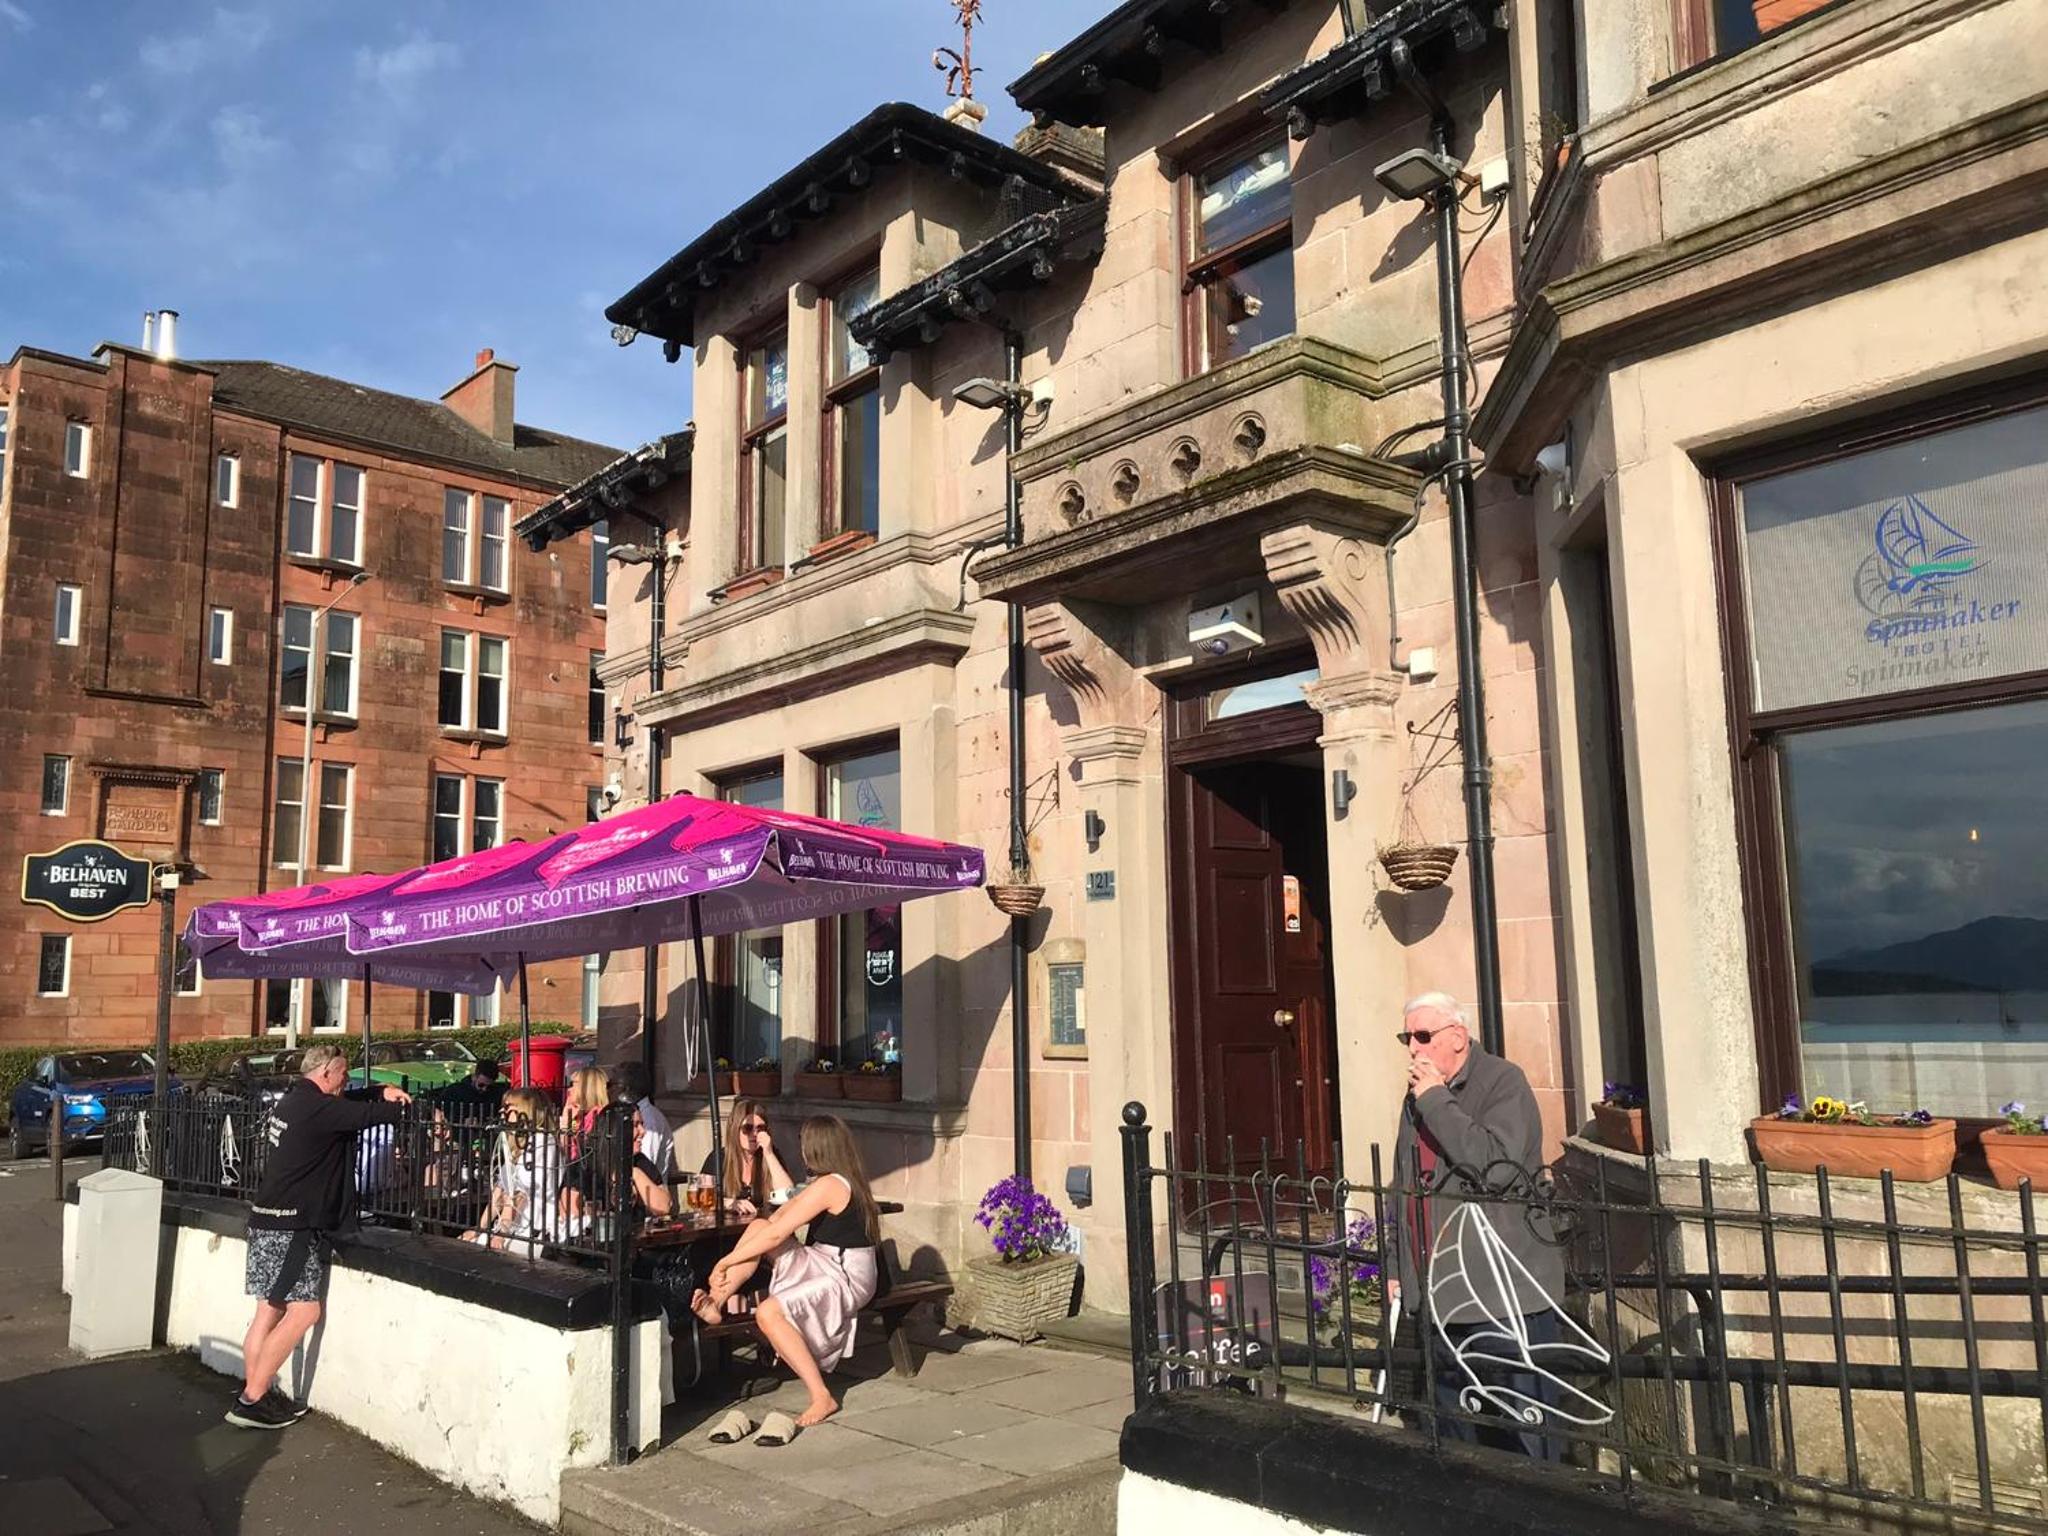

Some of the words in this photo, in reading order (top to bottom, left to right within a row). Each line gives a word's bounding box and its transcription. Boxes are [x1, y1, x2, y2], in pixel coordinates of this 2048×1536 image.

[817, 851, 836, 869] THE
[837, 853, 864, 872] HOME
[863, 855, 875, 873] OF
[875, 856, 915, 877] SCOTTISH
[915, 861, 950, 880] BREWING
[50, 865, 127, 885] BELHAVEN
[1090, 872, 1108, 888] 121
[70, 888, 106, 898] BEST
[419, 909, 451, 931] THE
[455, 900, 502, 925] HOME
[506, 896, 525, 915] OF
[531, 880, 611, 911] SCOTTISH
[616, 864, 690, 897] BREWING
[294, 918, 322, 934] THE
